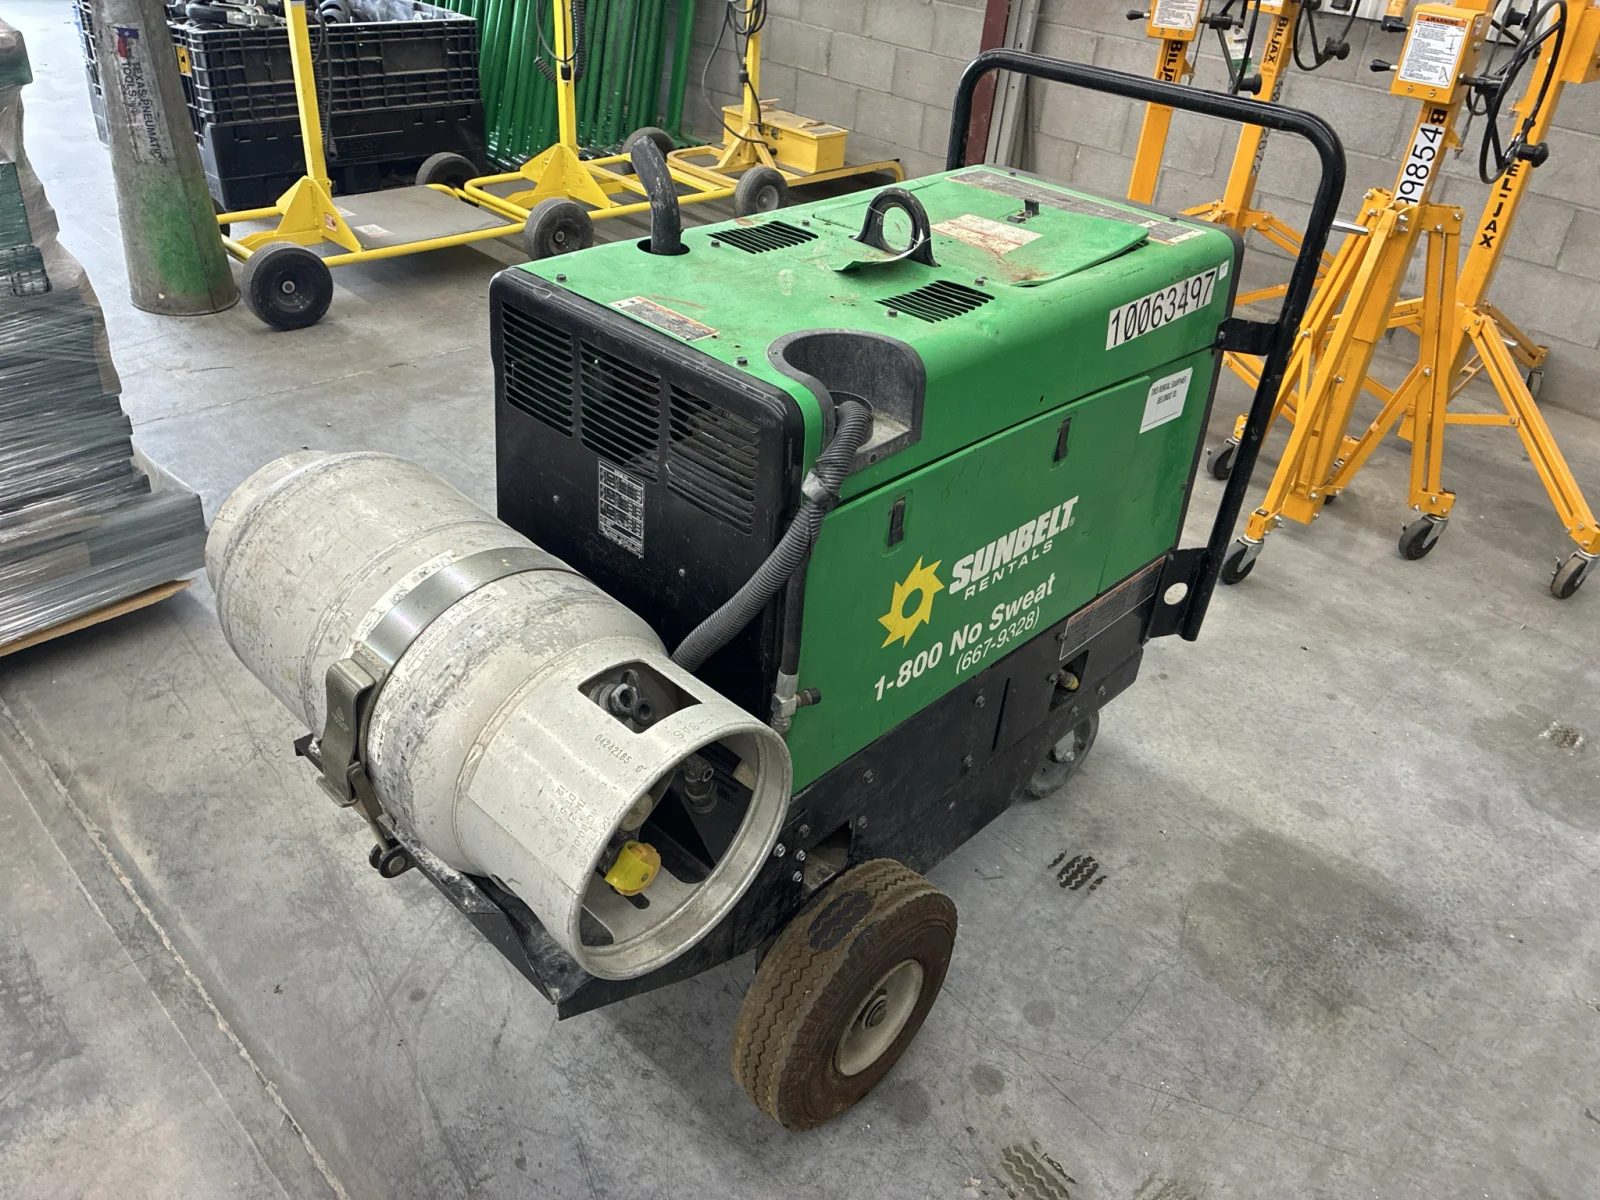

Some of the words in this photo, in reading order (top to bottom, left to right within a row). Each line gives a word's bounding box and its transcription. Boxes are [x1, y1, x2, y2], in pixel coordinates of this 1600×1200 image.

[1430, 17, 1459, 26] WARNING
[130, 61, 148, 97] TEXAS
[1162, 40, 1183, 82] BILJA
[1111, 270, 1216, 347] 10063497
[949, 495, 1079, 595] SUNBELT
[963, 539, 1053, 601] RENTALS
[874, 641, 943, 702] 1-800
[949, 621, 983, 657] No
[988, 572, 1056, 631] Sweat
[955, 605, 1040, 675] (667-9328)
